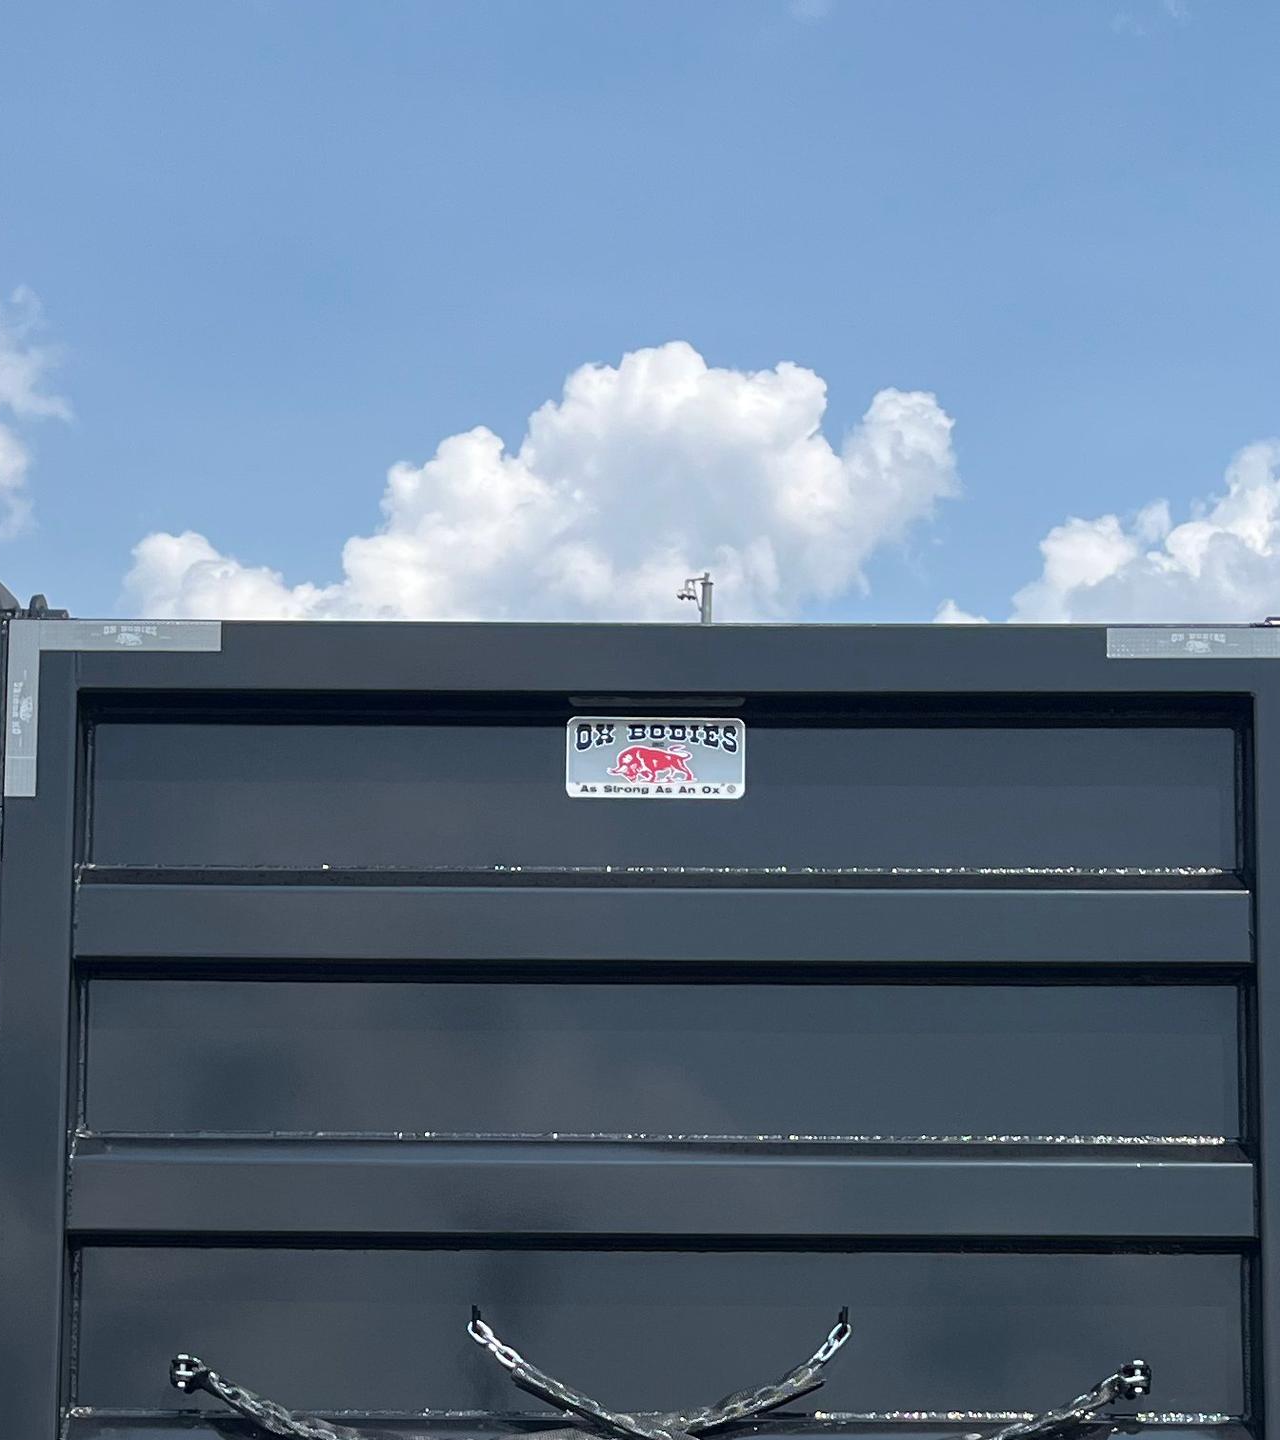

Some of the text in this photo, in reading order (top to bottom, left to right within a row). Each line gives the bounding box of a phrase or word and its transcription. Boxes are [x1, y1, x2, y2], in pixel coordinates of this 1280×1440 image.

[576, 723, 738, 753] OX BODIES
[604, 785, 649, 795] Strong
[655, 785, 673, 794] As
[678, 786, 696, 794] An
